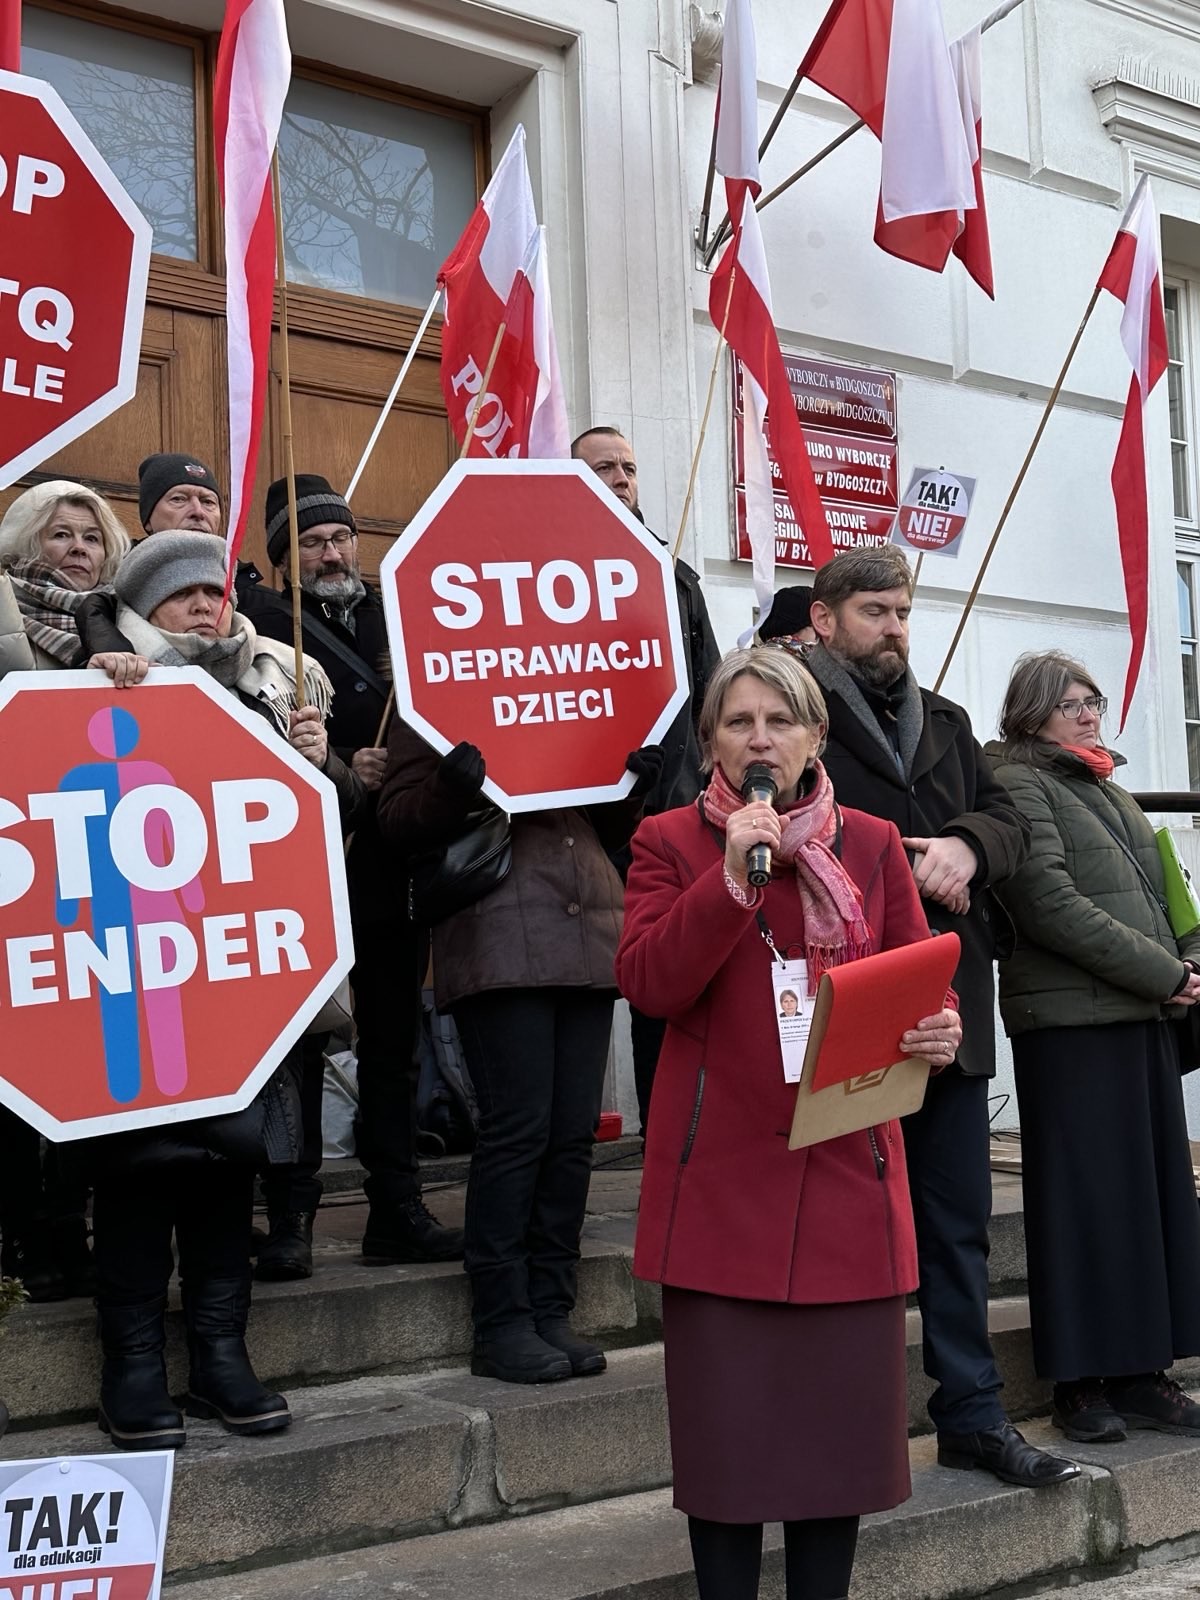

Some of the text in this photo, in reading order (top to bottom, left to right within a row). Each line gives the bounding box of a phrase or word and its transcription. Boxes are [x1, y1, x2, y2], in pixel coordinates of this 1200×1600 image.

[835, 375, 886, 399] BYDGOSZCZY
[793, 394, 830, 415] YBORCZY
[836, 402, 887, 425] BYDGOSZCZY
[806, 441, 891, 469] IURO WYBORCZE
[826, 471, 888, 496] BYDGOSZCZY
[917, 481, 960, 506] TAK!
[907, 510, 952, 539] NIE!
[430, 558, 638, 630] STOP
[423, 639, 663, 684] DEPRAWACJI
[492, 688, 615, 727] DZIECI
[5, 908, 312, 1008] ENDER
[4, 1491, 125, 1553] TAK!
[13, 1547, 103, 1569] dla edukacji
